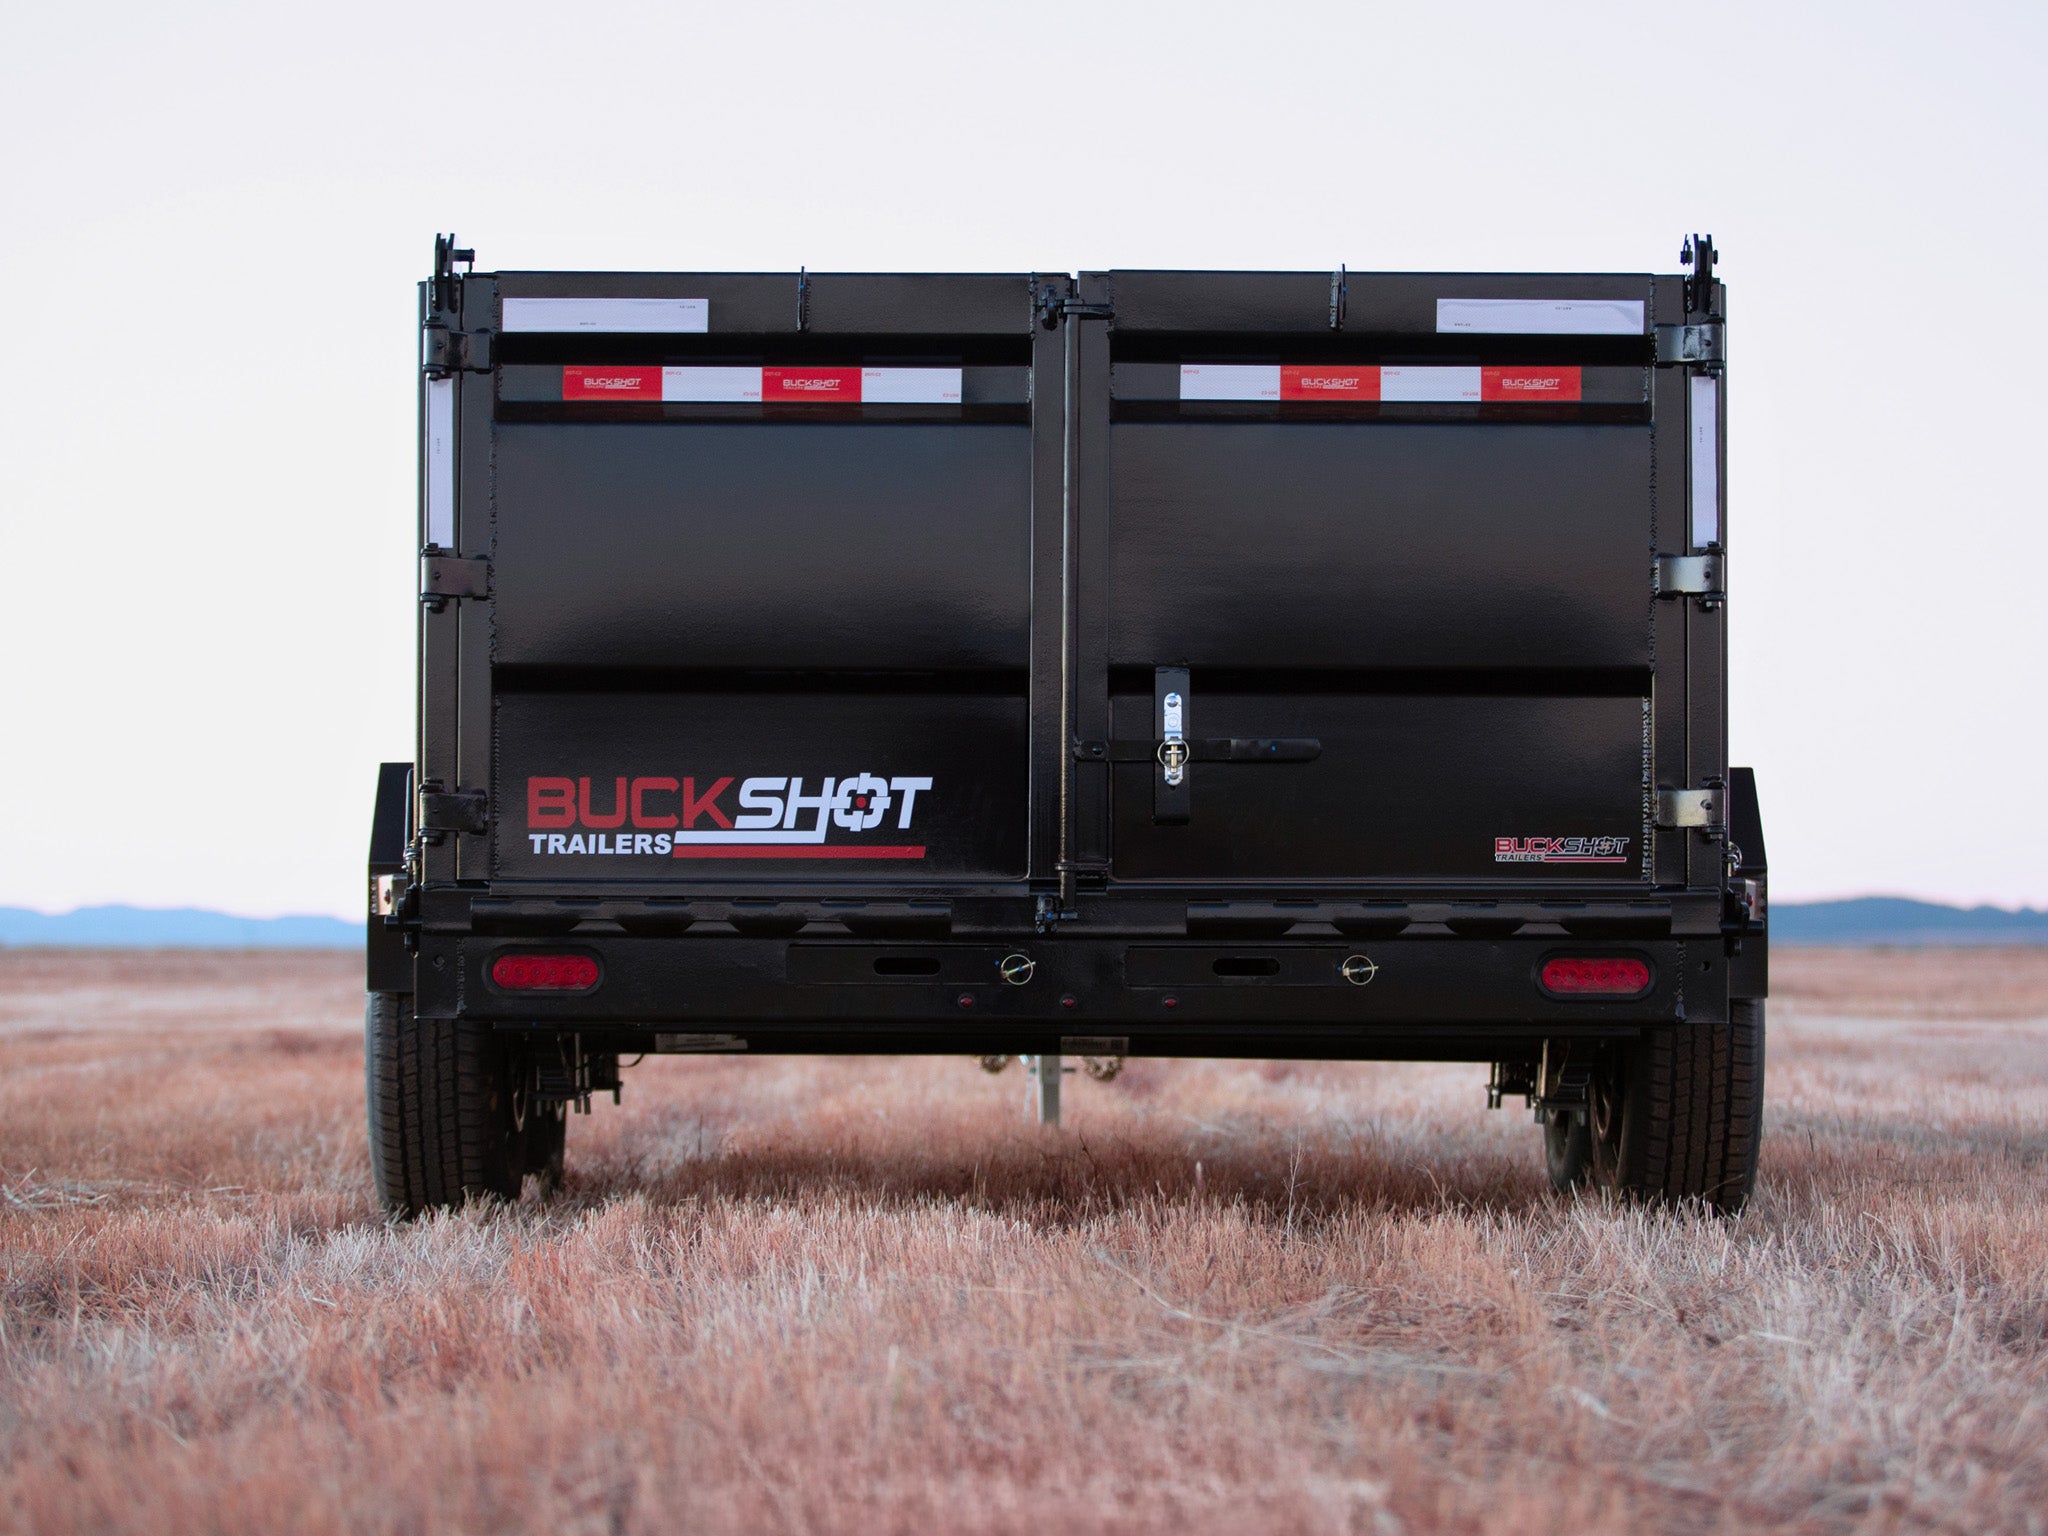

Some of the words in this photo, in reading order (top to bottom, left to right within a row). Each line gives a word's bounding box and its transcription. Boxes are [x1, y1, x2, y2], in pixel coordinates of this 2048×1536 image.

[583, 377, 642, 387] BUCKSHOT
[782, 379, 841, 388] BUCKSHOT
[1301, 377, 1360, 387] BUCKSHOT
[1502, 378, 1561, 387] BUCKSHOT
[527, 773, 933, 832] BUCKSHOT
[528, 834, 672, 855] TRAILERS
[1495, 836, 1630, 856] BUCKSHOT
[1495, 853, 1543, 862] TRAILERS
